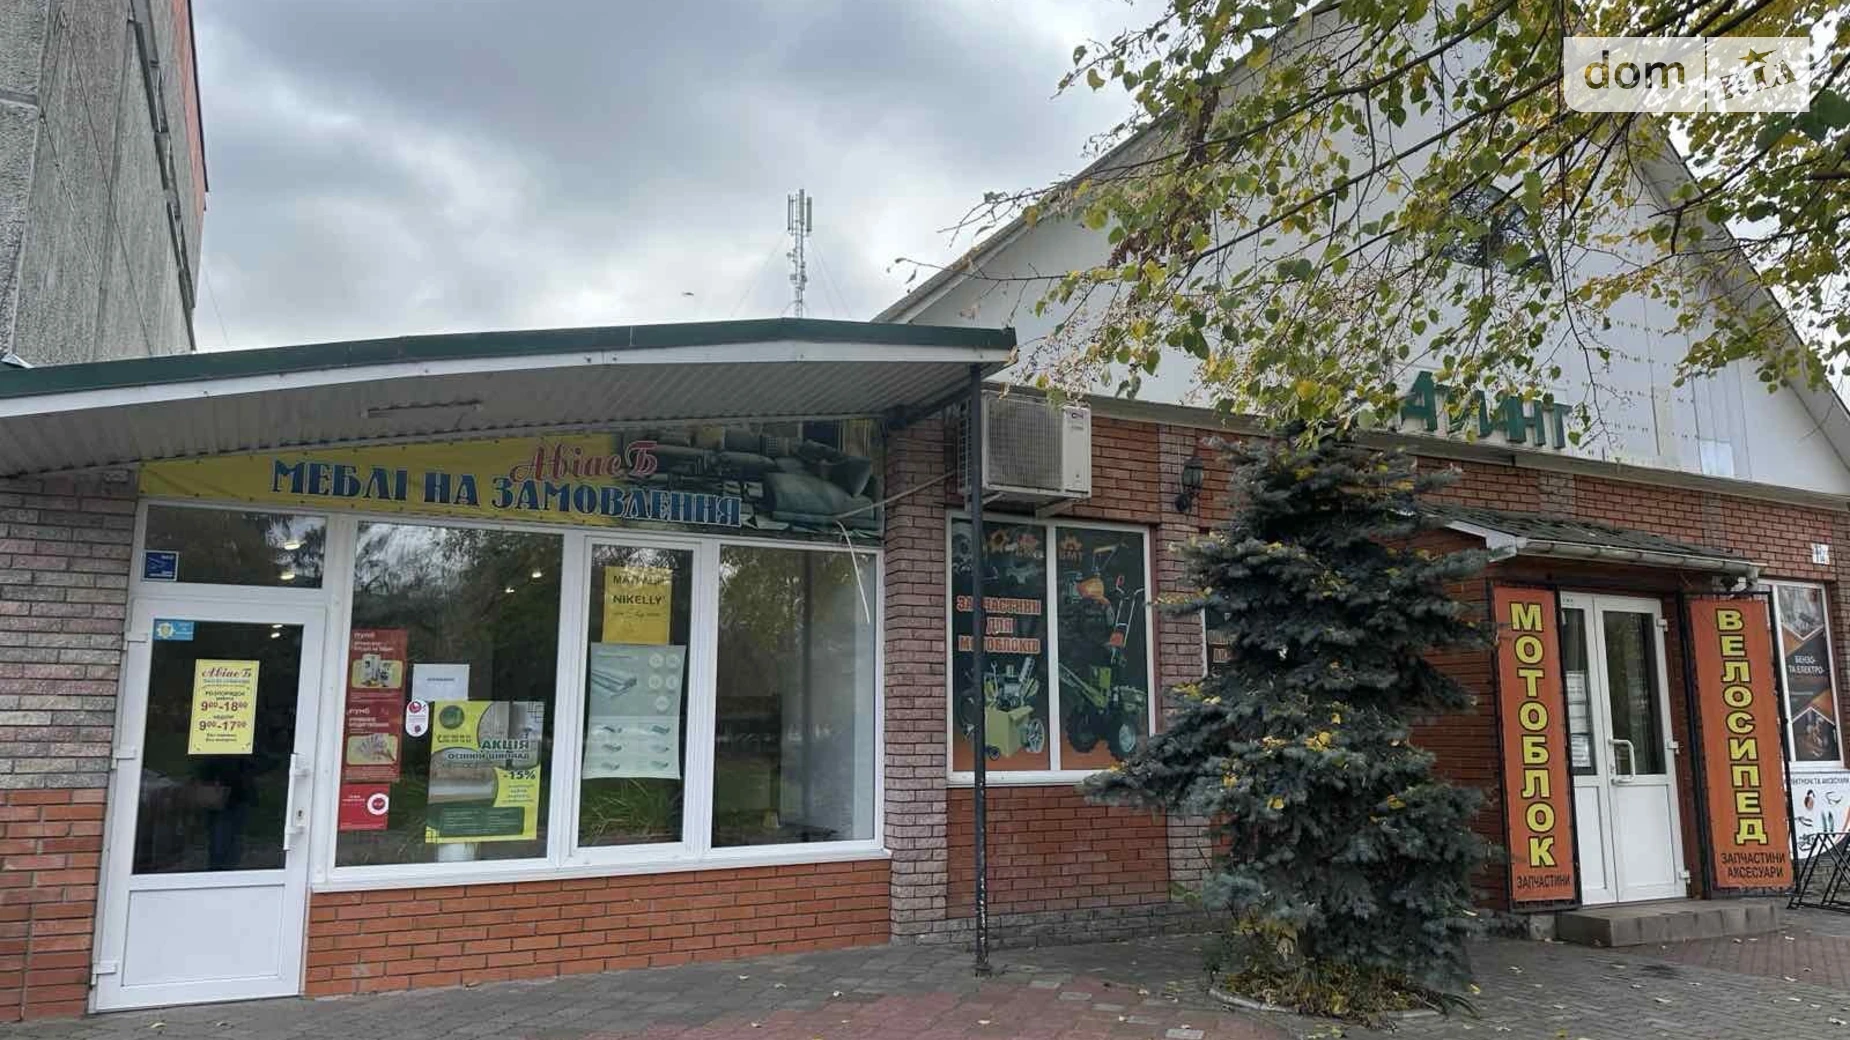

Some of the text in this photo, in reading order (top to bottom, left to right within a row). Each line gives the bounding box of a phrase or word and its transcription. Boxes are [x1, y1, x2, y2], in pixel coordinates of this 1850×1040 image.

[271, 459, 741, 527] МЕБЛІ НА ЗАМОВЛЕННЯ
[613, 594, 662, 605] NIKELLY
[956, 595, 1041, 615] ЗАЧАСТИНИ
[958, 635, 1041, 653] МОБЛОКІВ
[1509, 601, 1557, 868] МОТОБЛОК
[1715, 607, 1769, 846] ВЕЛОСИПЕД
[480, 739, 529, 750] АКЦІЯ
[503, 769, 537, 781] -15%
[1722, 851, 1786, 866] ЗАПЧАСТИНИ
[1726, 865, 1784, 879] АКСЕСУАРИ
[1516, 873, 1571, 889] ЗАПЧАСТИНИ
